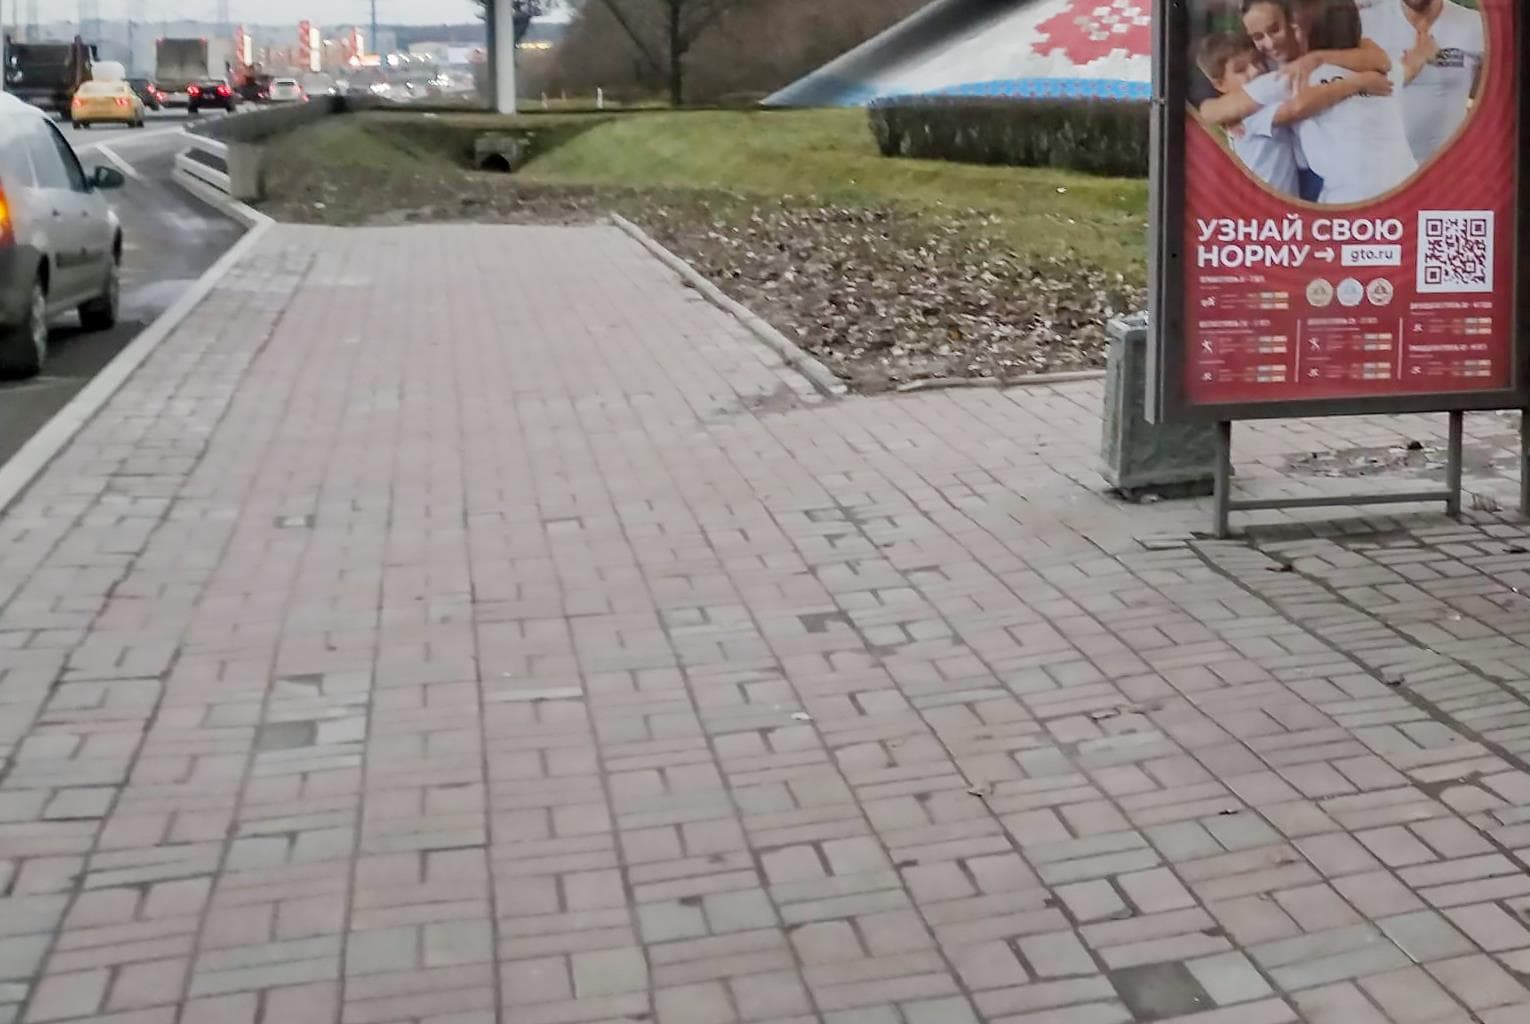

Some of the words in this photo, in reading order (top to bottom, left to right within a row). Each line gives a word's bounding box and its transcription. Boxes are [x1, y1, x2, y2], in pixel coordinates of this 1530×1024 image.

[1196, 213, 1303, 242] УЗНАЙ
[1311, 218, 1404, 242] СВОЮ
[1196, 244, 1311, 268] НОРМУ
[1350, 248, 1394, 263] gto.ru
